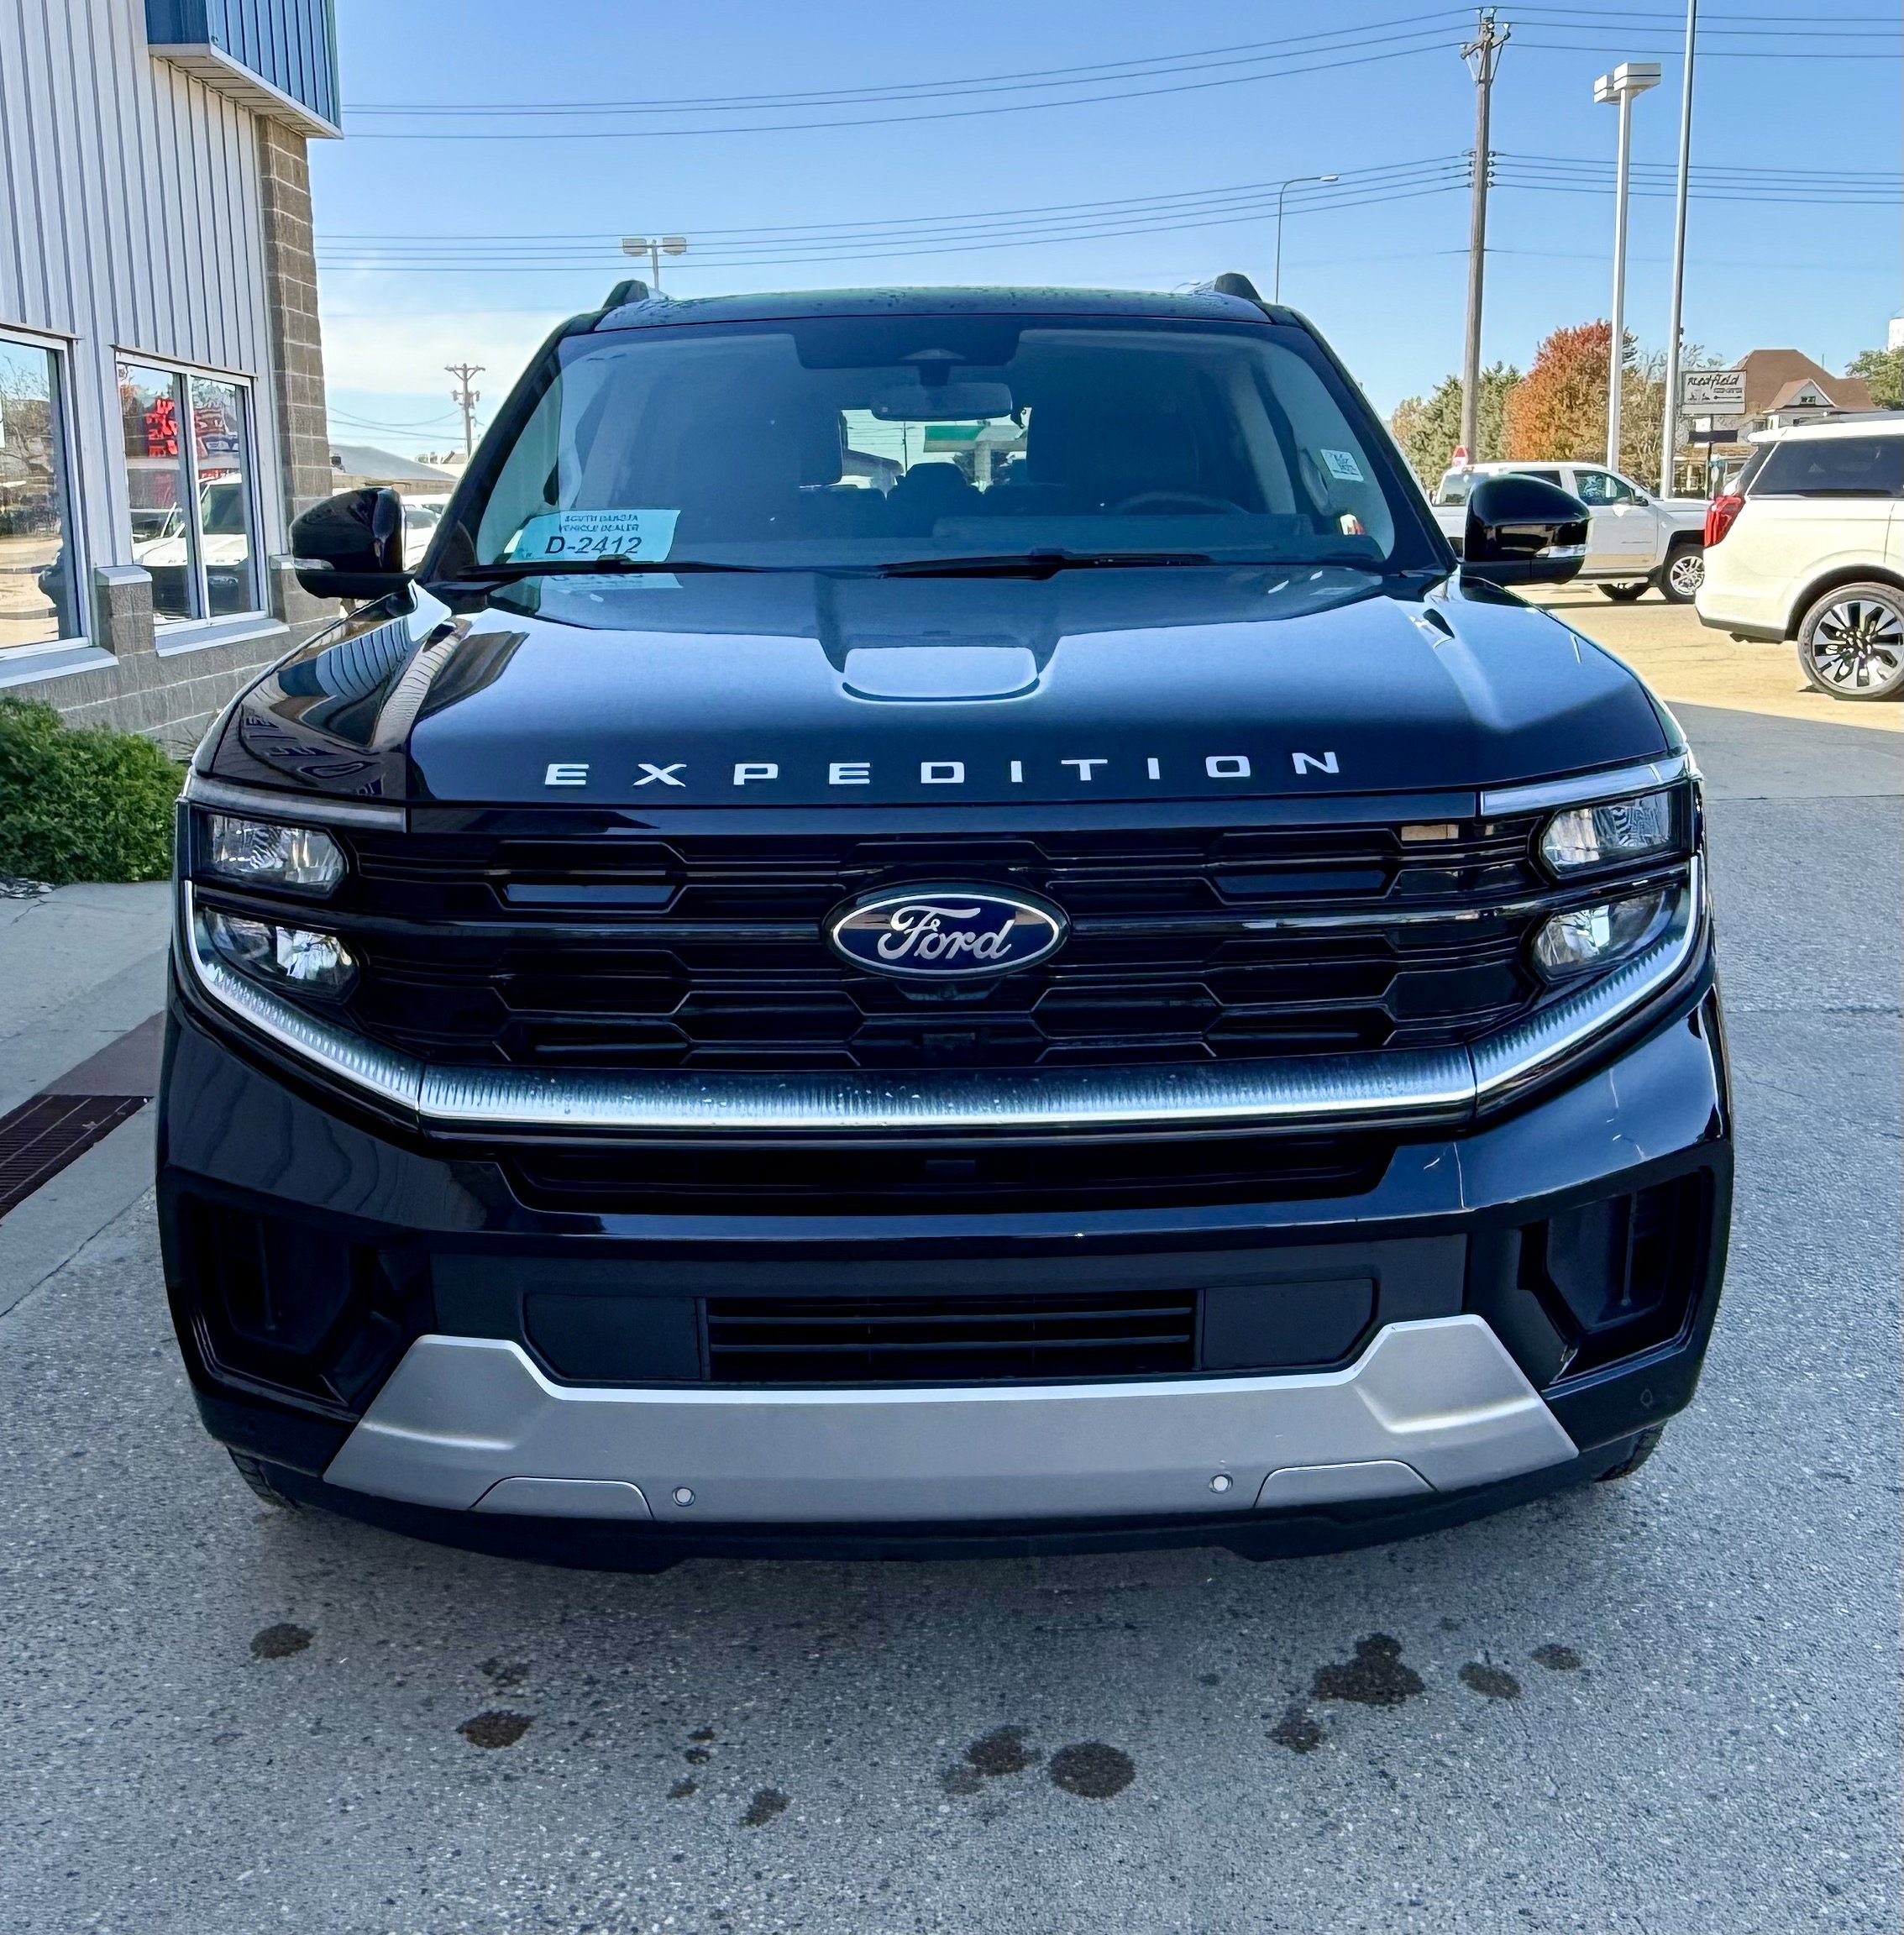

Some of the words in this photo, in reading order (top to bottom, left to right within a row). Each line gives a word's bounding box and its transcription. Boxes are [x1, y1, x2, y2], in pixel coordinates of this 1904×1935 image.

[601, 523, 639, 532] DEALER
[545, 536, 643, 554] D-2412
[543, 751, 1341, 789] EXPEDITION
[878, 905, 1015, 960] Ford
